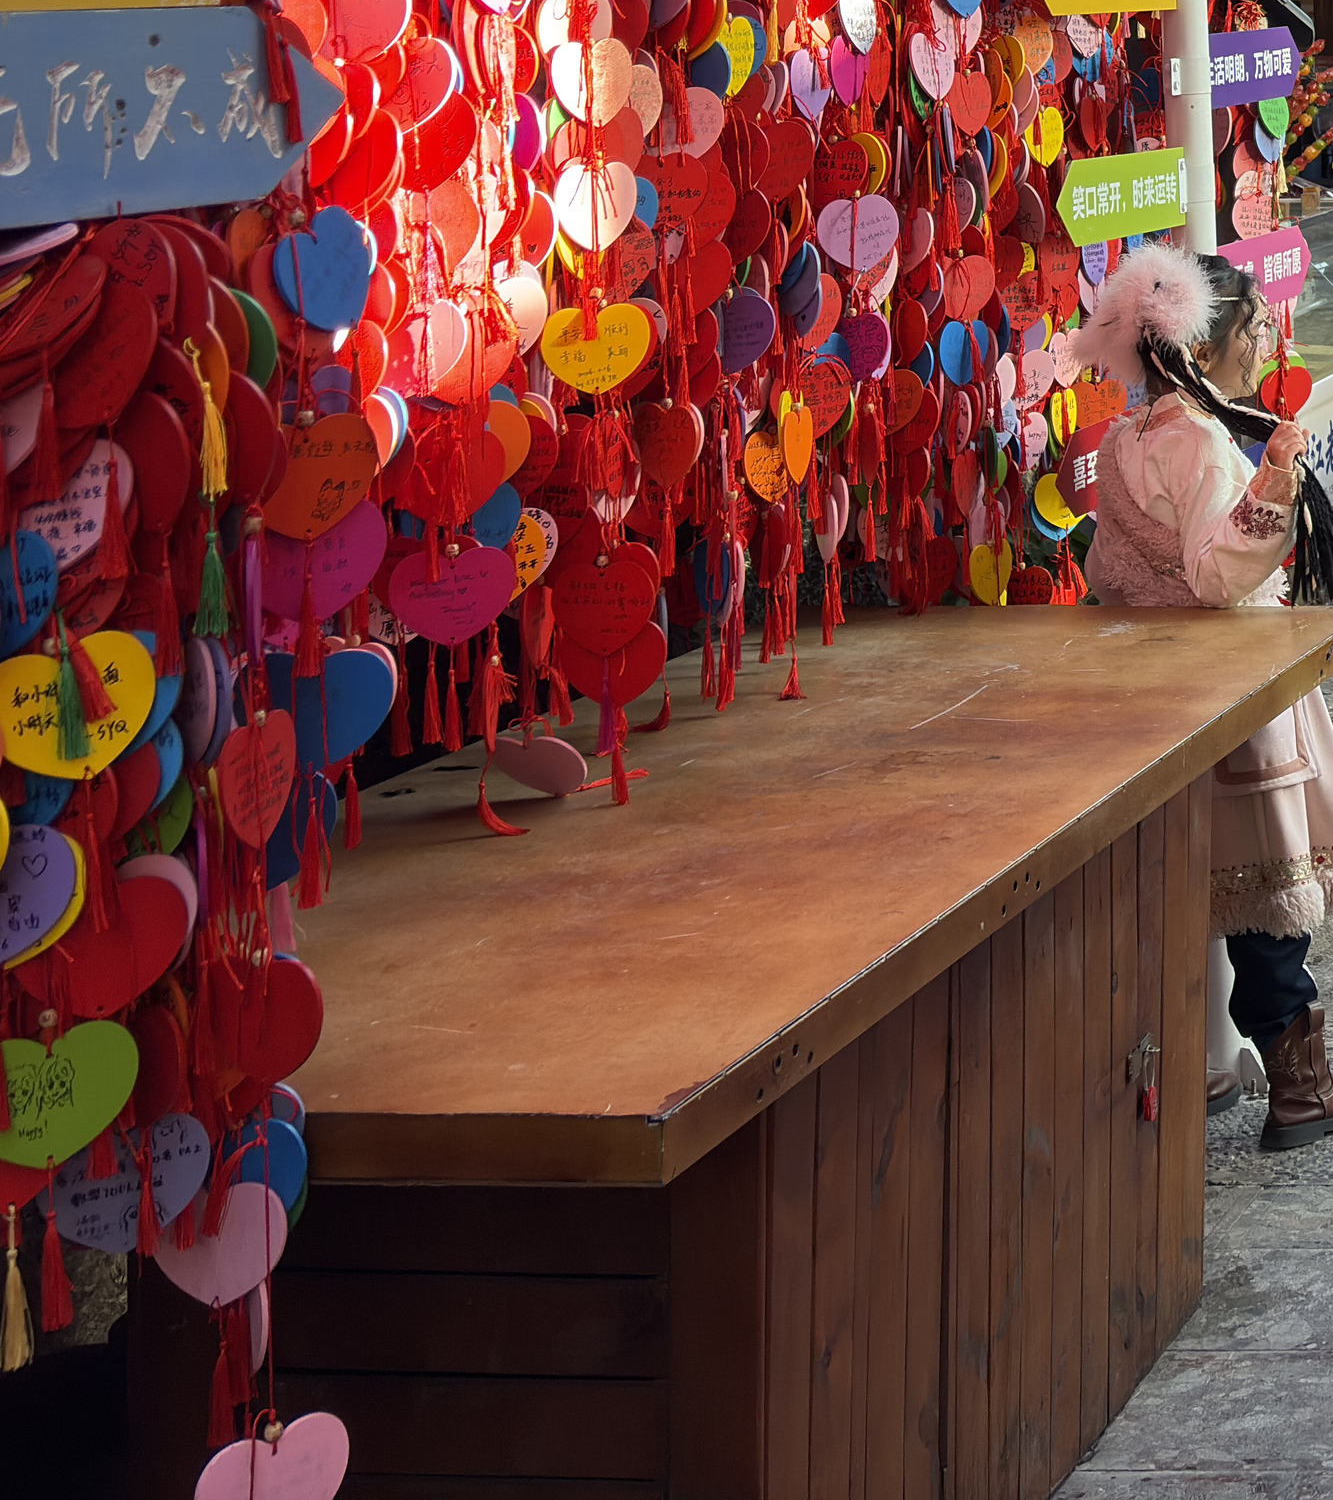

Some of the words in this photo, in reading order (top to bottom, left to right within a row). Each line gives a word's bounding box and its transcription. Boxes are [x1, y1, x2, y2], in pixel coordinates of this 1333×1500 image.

[1072, 172, 1178, 221] 笑口常开，时来运转
